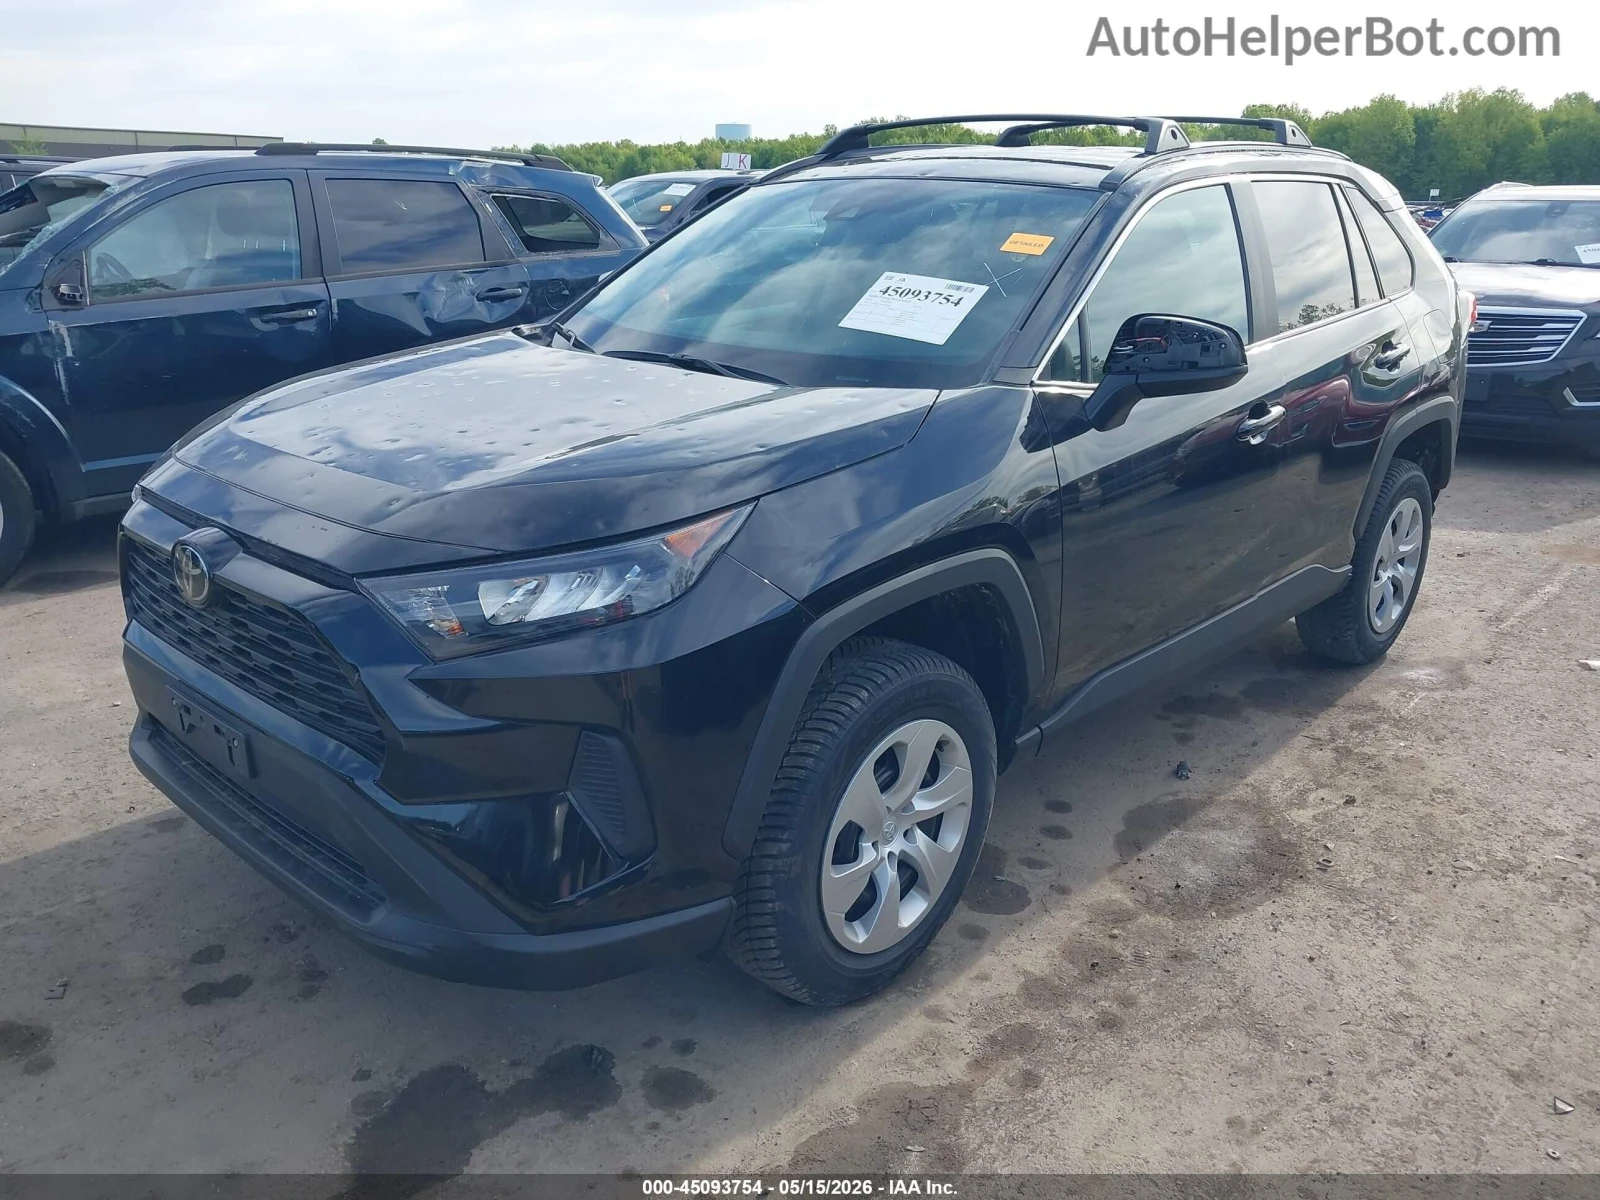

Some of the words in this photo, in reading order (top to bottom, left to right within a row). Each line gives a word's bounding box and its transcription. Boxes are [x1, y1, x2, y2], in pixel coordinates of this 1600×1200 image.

[724, 153, 730, 168] J
[738, 154, 748, 170] K
[1009, 240, 1044, 248] DETAILED
[879, 285, 964, 307] 45093754
